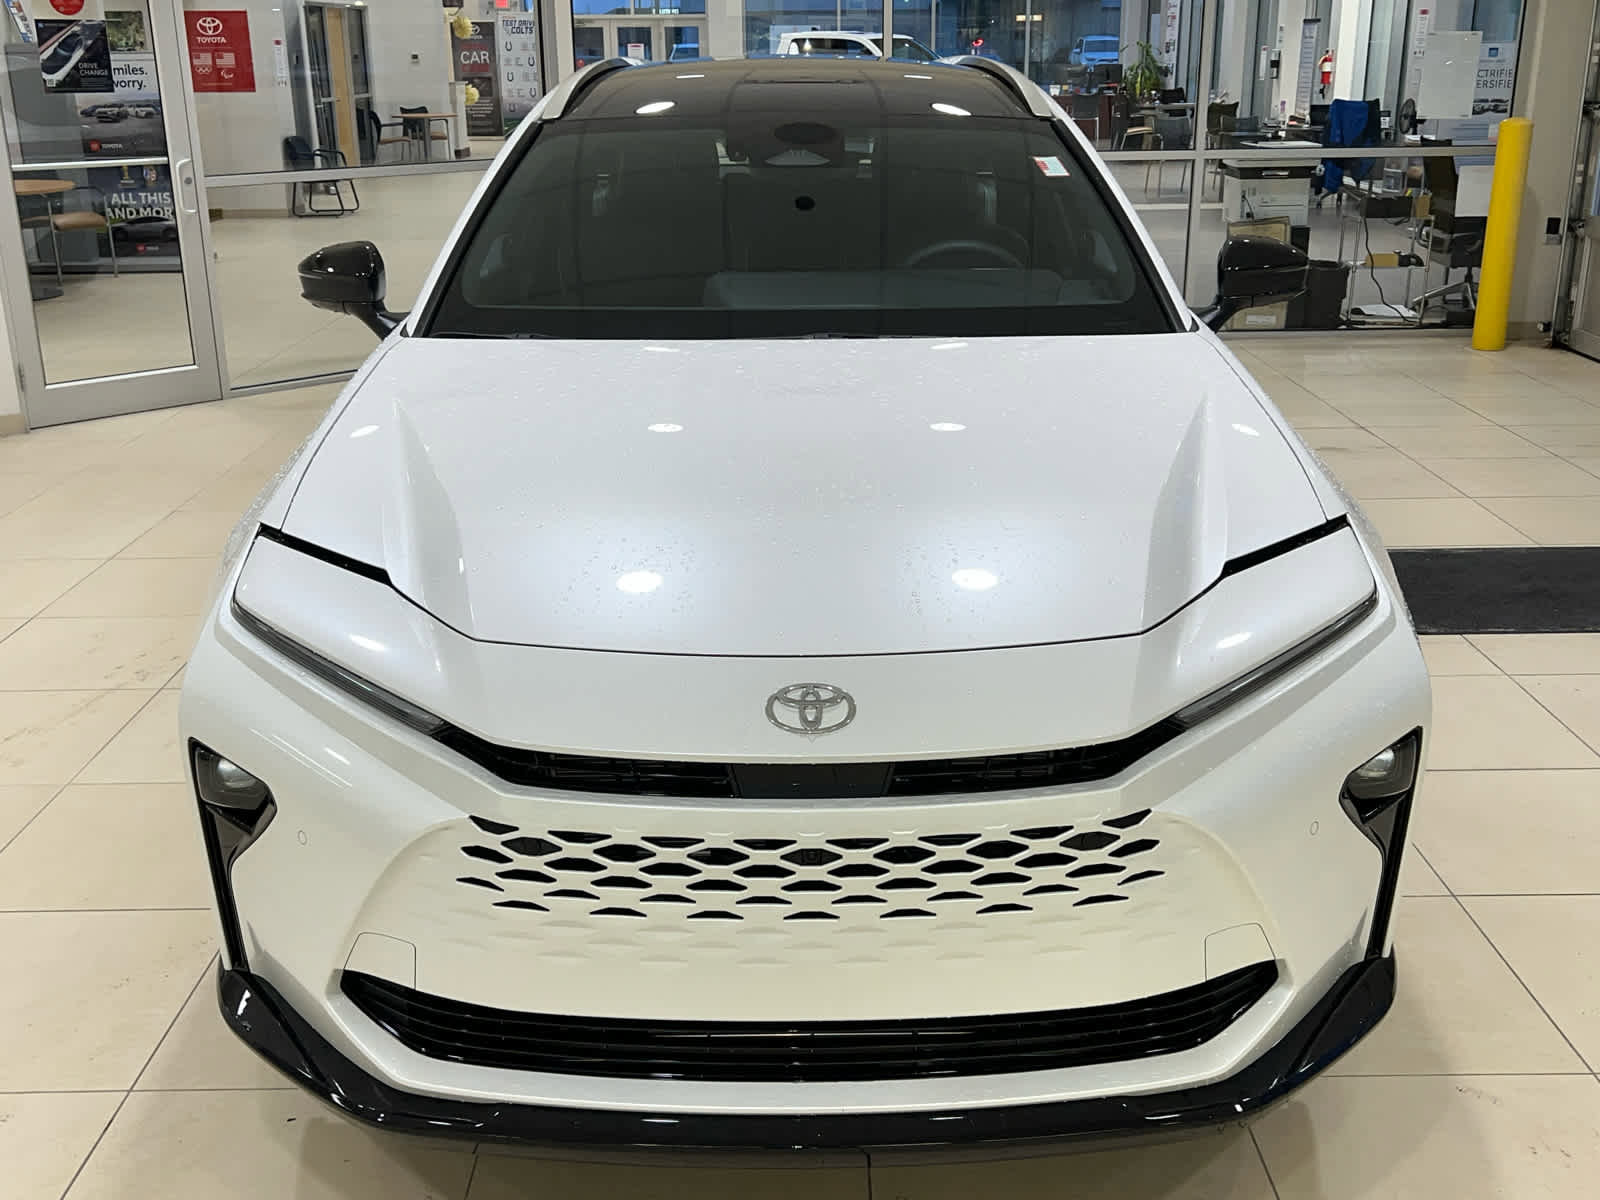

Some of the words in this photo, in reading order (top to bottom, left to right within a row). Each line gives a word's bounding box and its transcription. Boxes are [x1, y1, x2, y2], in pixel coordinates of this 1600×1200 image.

[511, 26, 534, 34] COLTS
[460, 51, 490, 64] CAR
[113, 63, 148, 76] miles.
[1477, 69, 1513, 79] CTRIFIE
[1476, 80, 1513, 88] ERSIFIE
[111, 191, 137, 205] ALL
[138, 191, 171, 204] THIS
[106, 207, 137, 219] AND
[139, 207, 174, 218] MOR
